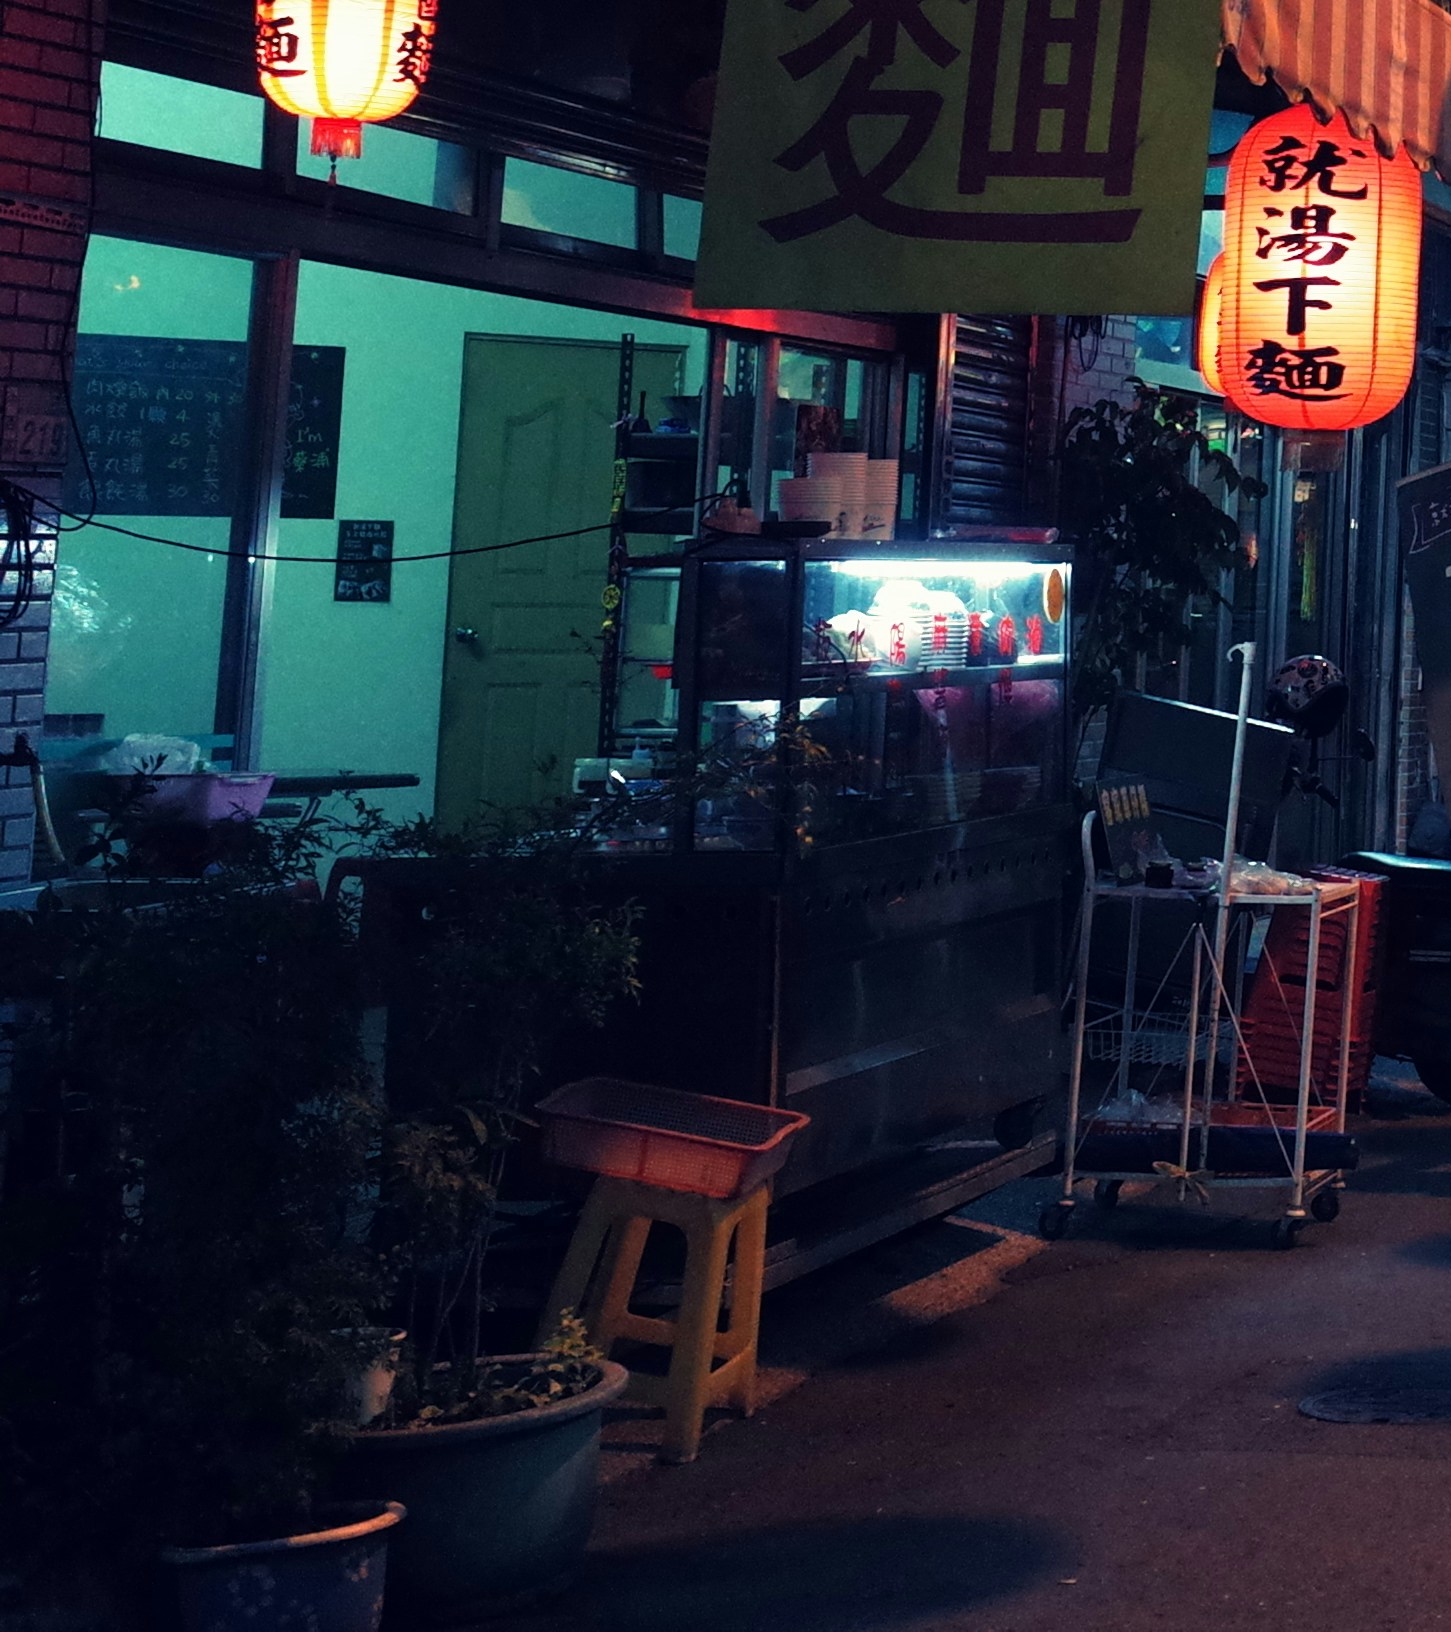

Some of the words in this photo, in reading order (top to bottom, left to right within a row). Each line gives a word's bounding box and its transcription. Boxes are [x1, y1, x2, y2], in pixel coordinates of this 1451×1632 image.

[1243, 134, 1368, 402] 就湯下麵
[175, 389, 195, 402] 20
[168, 431, 192, 448] 25
